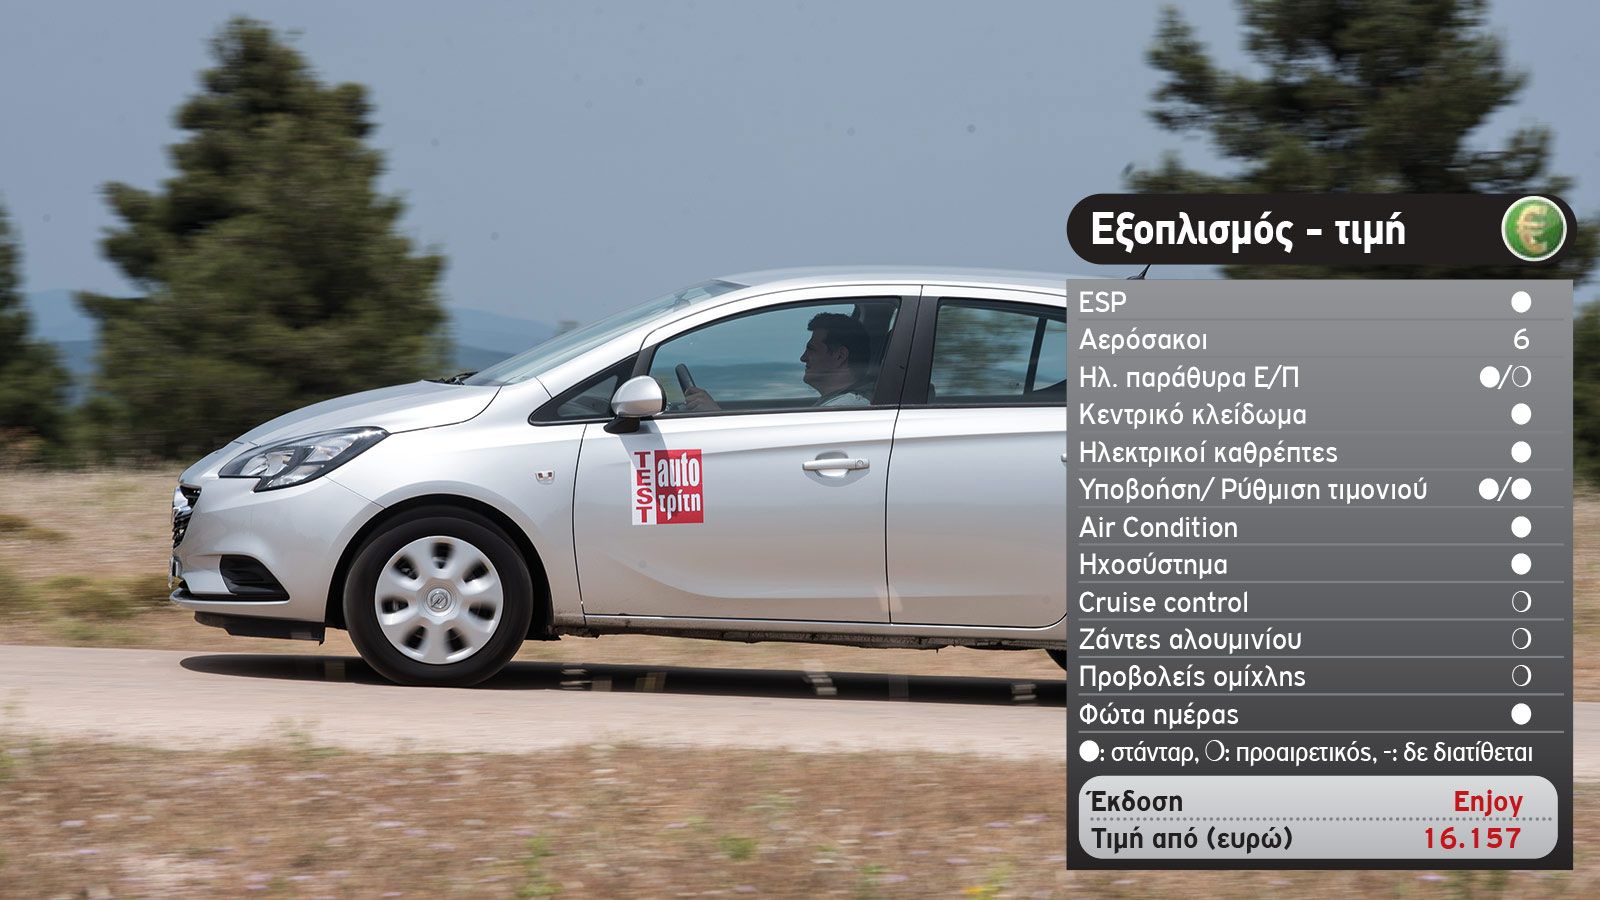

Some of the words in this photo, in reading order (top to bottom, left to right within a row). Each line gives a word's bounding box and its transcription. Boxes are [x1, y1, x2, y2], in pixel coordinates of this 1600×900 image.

[634, 451, 653, 523] TEST
[657, 452, 700, 487] auto
[658, 489, 701, 520] τρίτη
